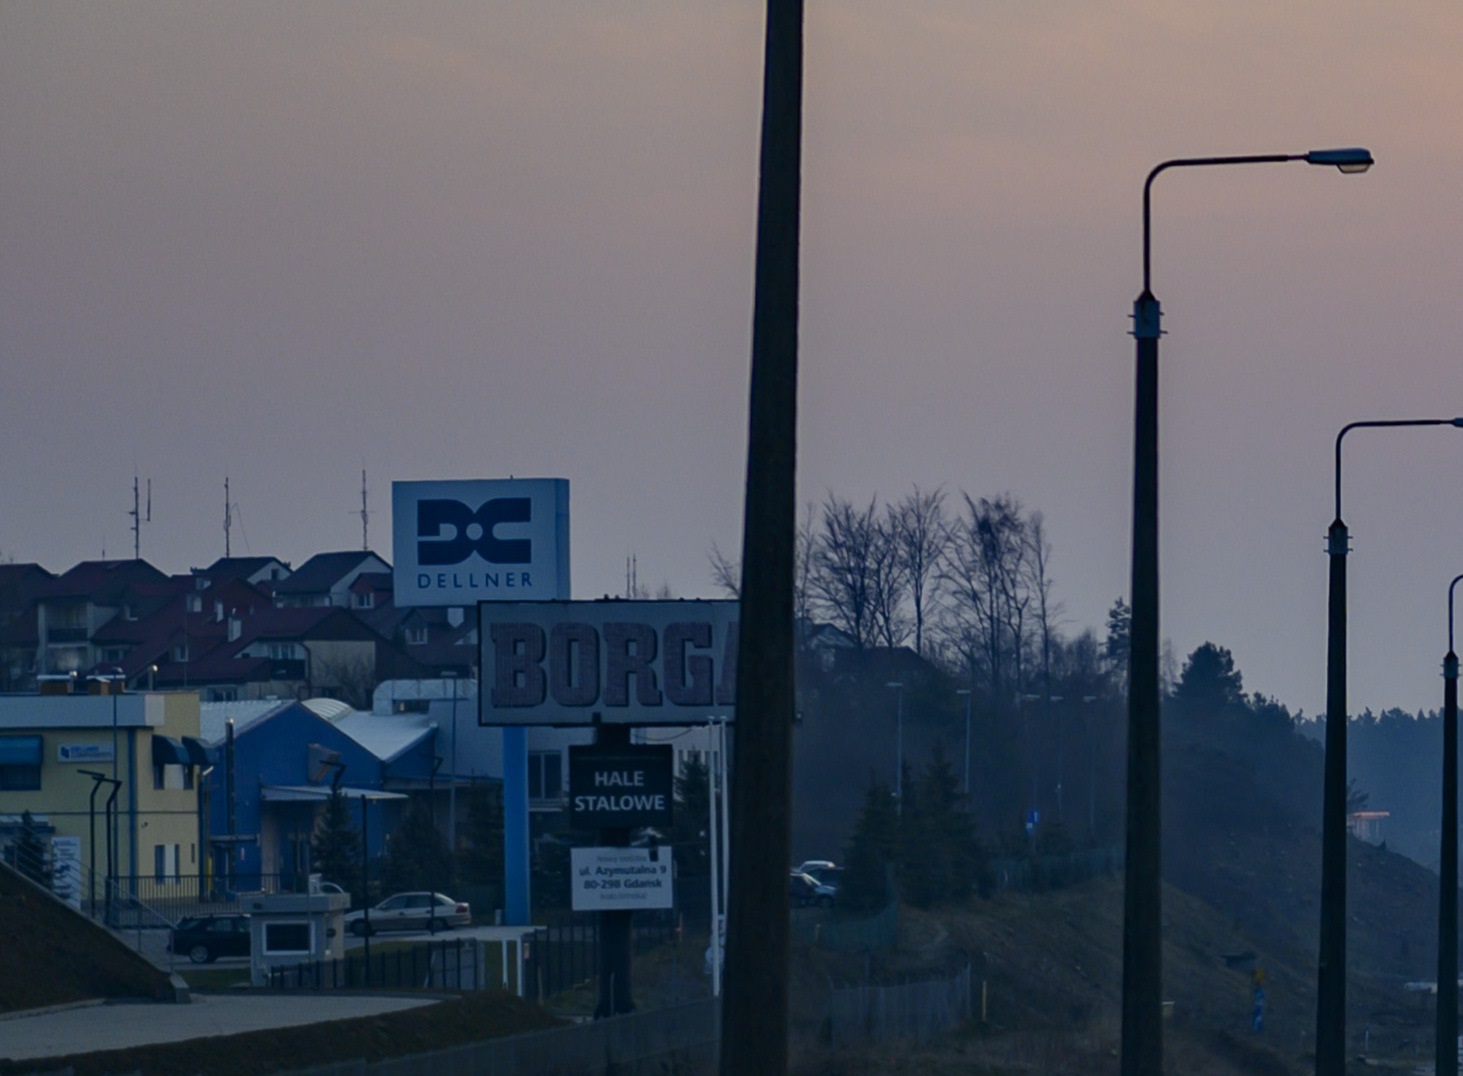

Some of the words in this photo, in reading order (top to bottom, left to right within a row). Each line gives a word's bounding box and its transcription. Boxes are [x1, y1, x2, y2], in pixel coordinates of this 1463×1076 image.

[417, 572, 532, 589] DELLNER
[594, 770, 645, 787] HALE
[574, 794, 665, 812] STALOWE
[659, 864, 667, 875] 9
